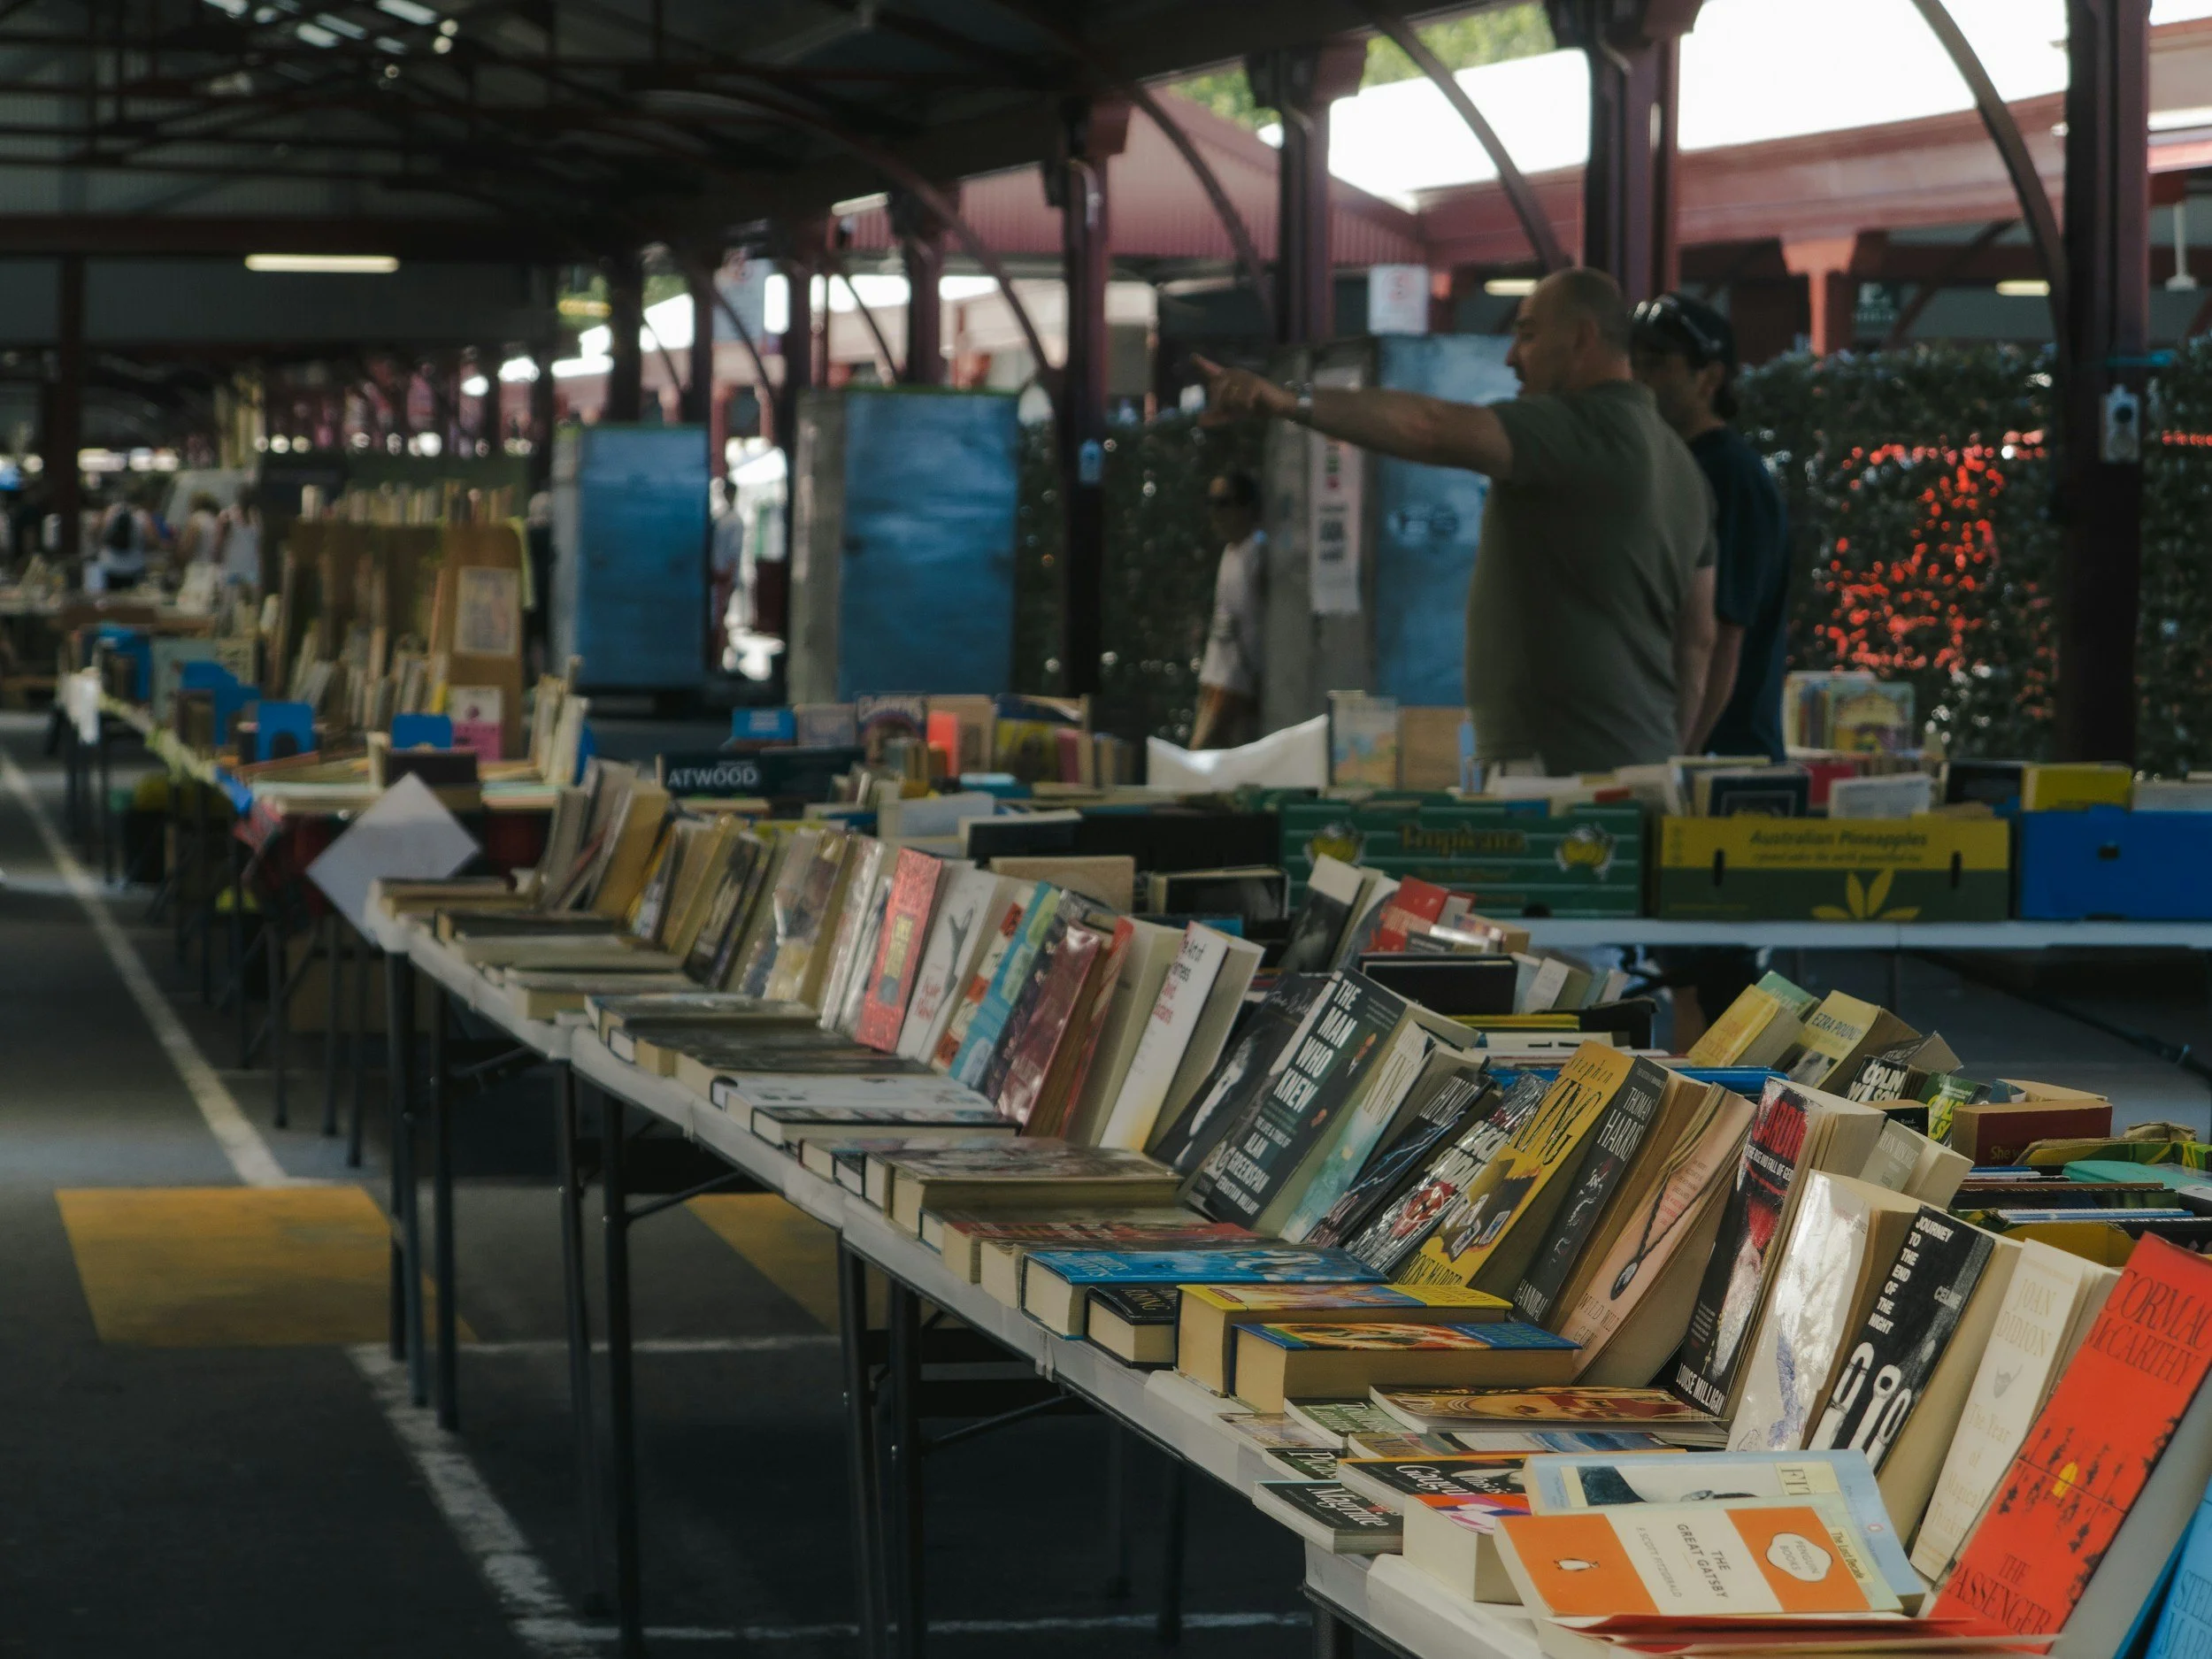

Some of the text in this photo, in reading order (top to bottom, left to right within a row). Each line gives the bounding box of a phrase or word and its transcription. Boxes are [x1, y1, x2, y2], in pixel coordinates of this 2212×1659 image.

[668, 767, 759, 787] ATWOOD
[1751, 829, 1927, 853] Australian Pineapples
[1333, 979, 1363, 1011] THE
[1317, 1006, 1358, 1048] MAN
[1812, 1011, 1837, 1033] EZRA
[1295, 1035, 1334, 1079] WHO
[1568, 1055, 1614, 1085] stephen
[1273, 1067, 1318, 1113] KNEW
[1862, 1061, 1907, 1093] COLIN
[1624, 1086, 1656, 1122] THOMAS
[1507, 1078, 1603, 1166] KING
[1597, 1109, 1645, 1162] HARRIS
[1243, 1131, 1270, 1160] ALAN
[1991, 1145, 2011, 1162] She
[1226, 1150, 1271, 1194] GREENSPAN
[1766, 1157, 1778, 1174] FALL
[1776, 1164, 1785, 1178] OF
[1909, 1232, 1921, 1247] TO
[1916, 1216, 1954, 1242] JOURNEY
[1892, 1264, 1911, 1282] END
[1901, 1248, 1919, 1266] THE
[1512, 1279, 1549, 1323] HANNIBAL
[1885, 1280, 1899, 1295] OF
[2012, 1278, 2057, 1317] JOAN
[1877, 1296, 1894, 1315] THE
[2105, 1268, 2212, 1350] CORMAC
[1868, 1313, 1894, 1334] NIGHT
[1996, 1310, 2052, 1357] DIDION
[1676, 1363, 1726, 1416] LOUISE MILLIGAN
[1966, 1403, 2012, 1445] The Year
[1967, 1447, 1985, 1469] of
[1305, 1487, 1389, 1526] Magritte
[1640, 1532, 1661, 1558] SCOTT
[1653, 1554, 1683, 1599] FITZGERALD
[1677, 1524, 1729, 1599] GREAT GATSBY
[1711, 1550, 1732, 1571] THE
[1779, 1544, 1802, 1571] BOOKS
[1794, 1540, 1820, 1575] PENGUIN
[1832, 1531, 1843, 1545] The
[1845, 1556, 1864, 1578] Decade
[1998, 1553, 2031, 1586] THE
[1947, 1561, 2053, 1635] PASSENGER
[2173, 1570, 2212, 1627] STEL
